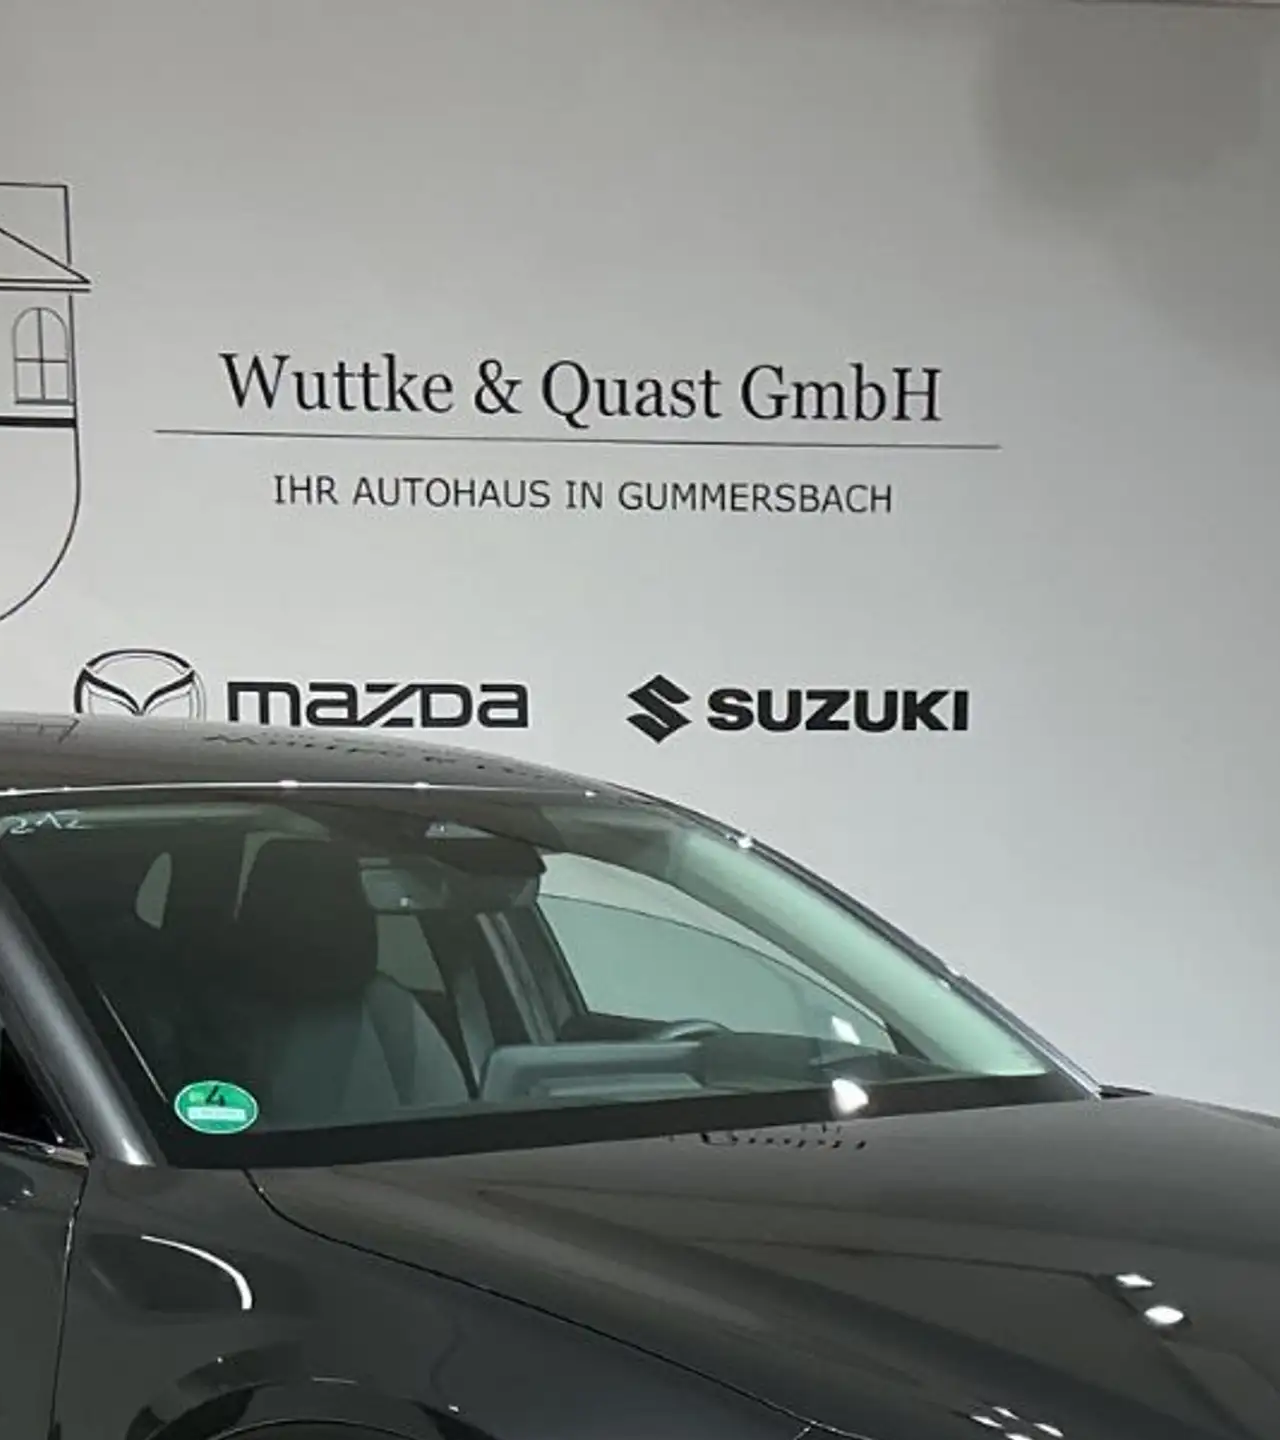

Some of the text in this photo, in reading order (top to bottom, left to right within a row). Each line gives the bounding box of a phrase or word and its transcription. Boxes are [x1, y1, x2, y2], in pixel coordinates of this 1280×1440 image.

[218, 352, 943, 429] Wuttke & Quast GmbH
[273, 474, 893, 515] IHR AUTOHAUS IN GUMMERSBACH
[707, 688, 970, 734] SUZUKI
